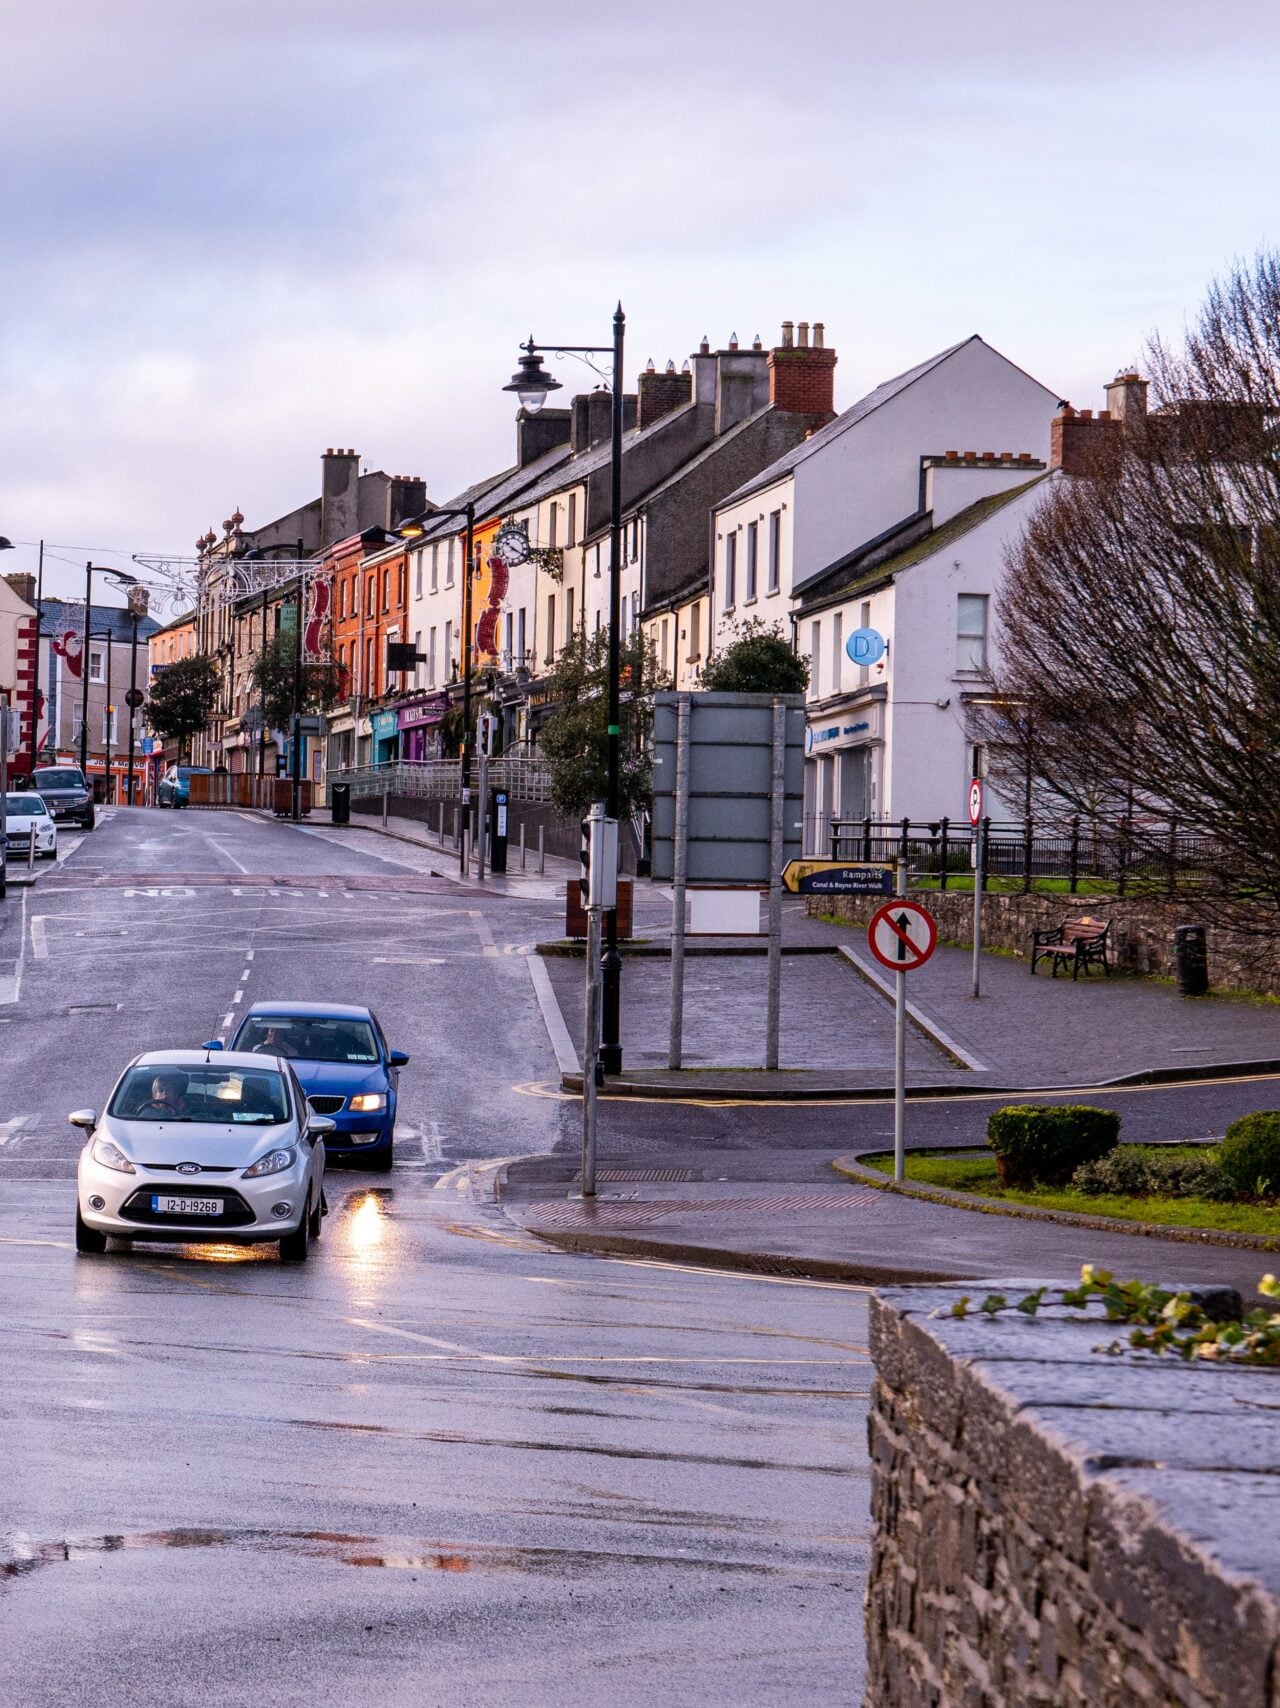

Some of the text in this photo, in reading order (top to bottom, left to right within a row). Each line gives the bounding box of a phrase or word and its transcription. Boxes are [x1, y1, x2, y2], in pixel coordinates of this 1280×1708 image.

[842, 870, 883, 880] Ramparts
[835, 882, 852, 890] Boyne
[124, 888, 196, 897] NO
[167, 1199, 218, 1213] 12-D-19268
